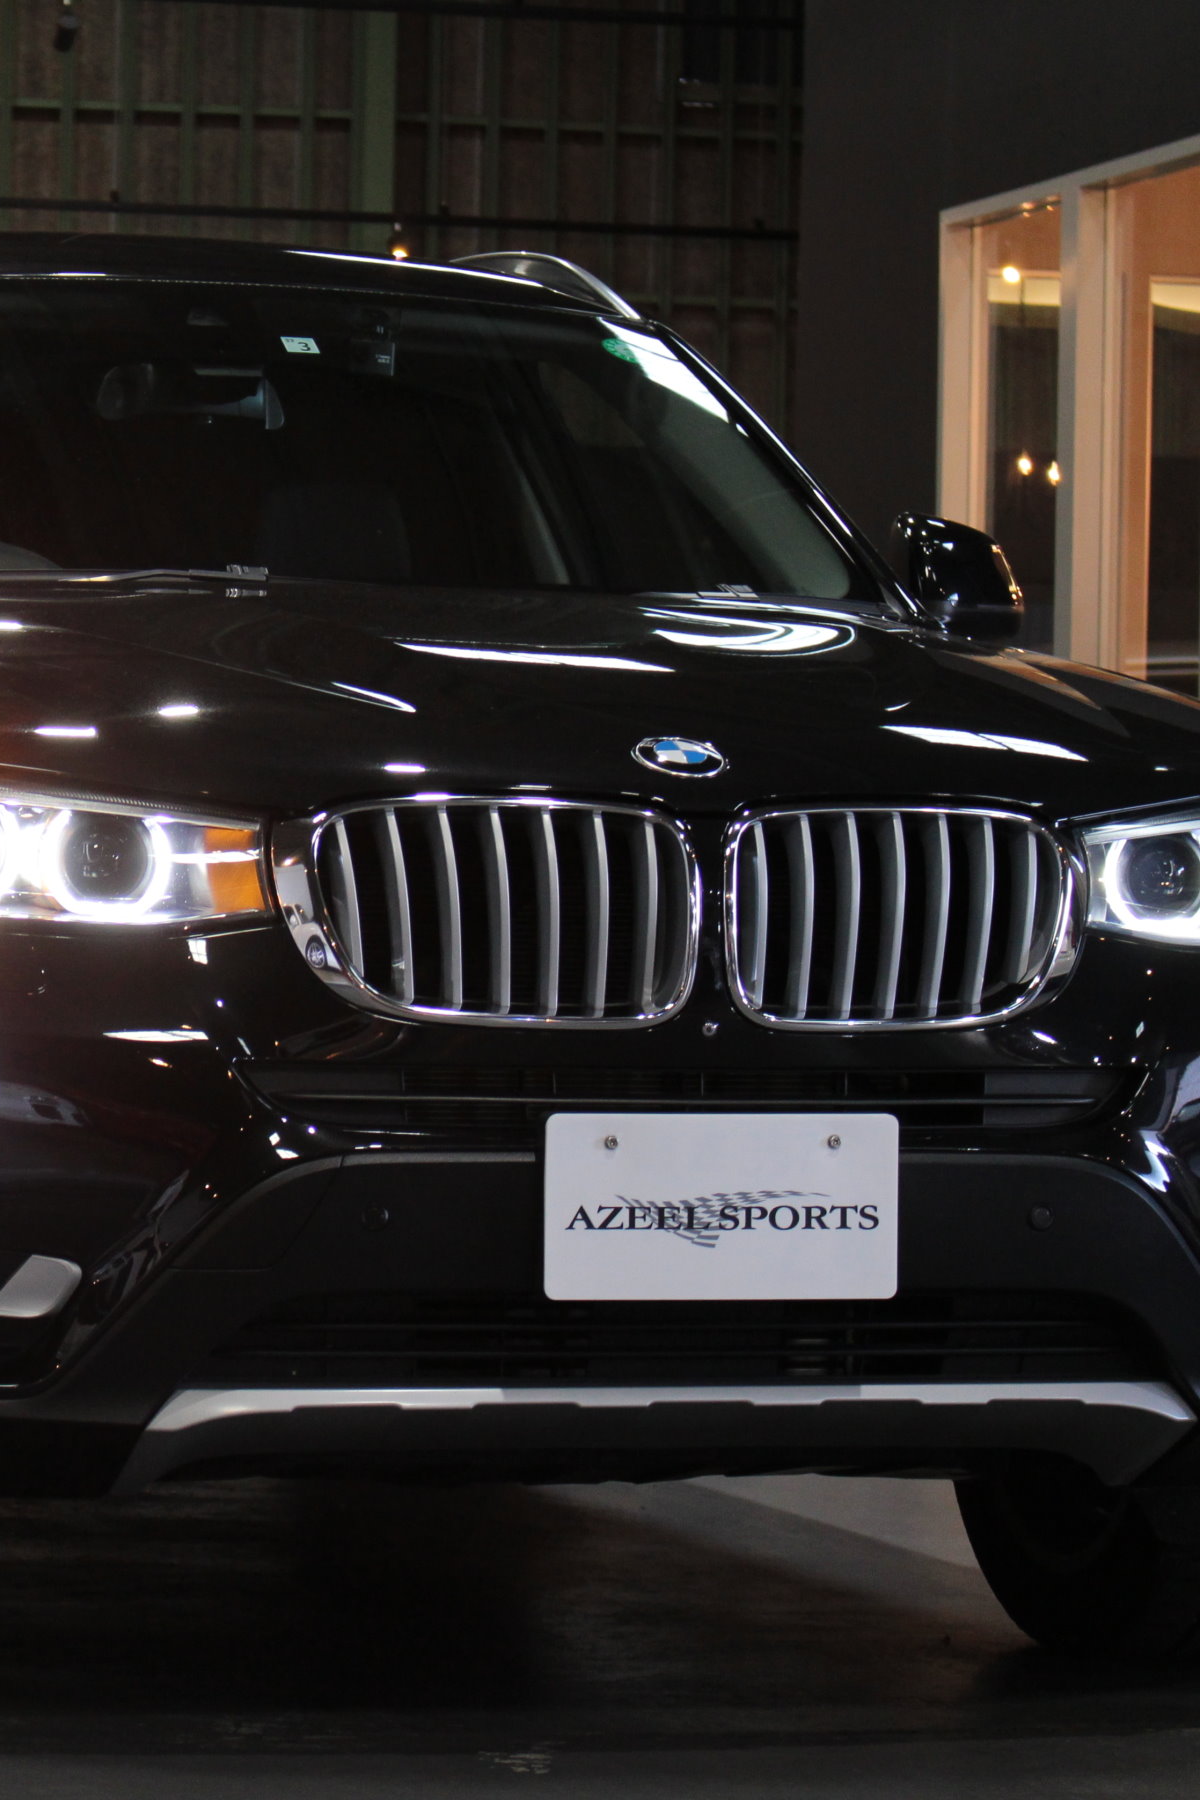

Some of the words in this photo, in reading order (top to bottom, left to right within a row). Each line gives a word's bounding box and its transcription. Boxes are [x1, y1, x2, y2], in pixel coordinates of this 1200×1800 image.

[297, 341, 311, 351] 3
[565, 1204, 711, 1231] AZEEL
[718, 1204, 880, 1231] SPORTS
